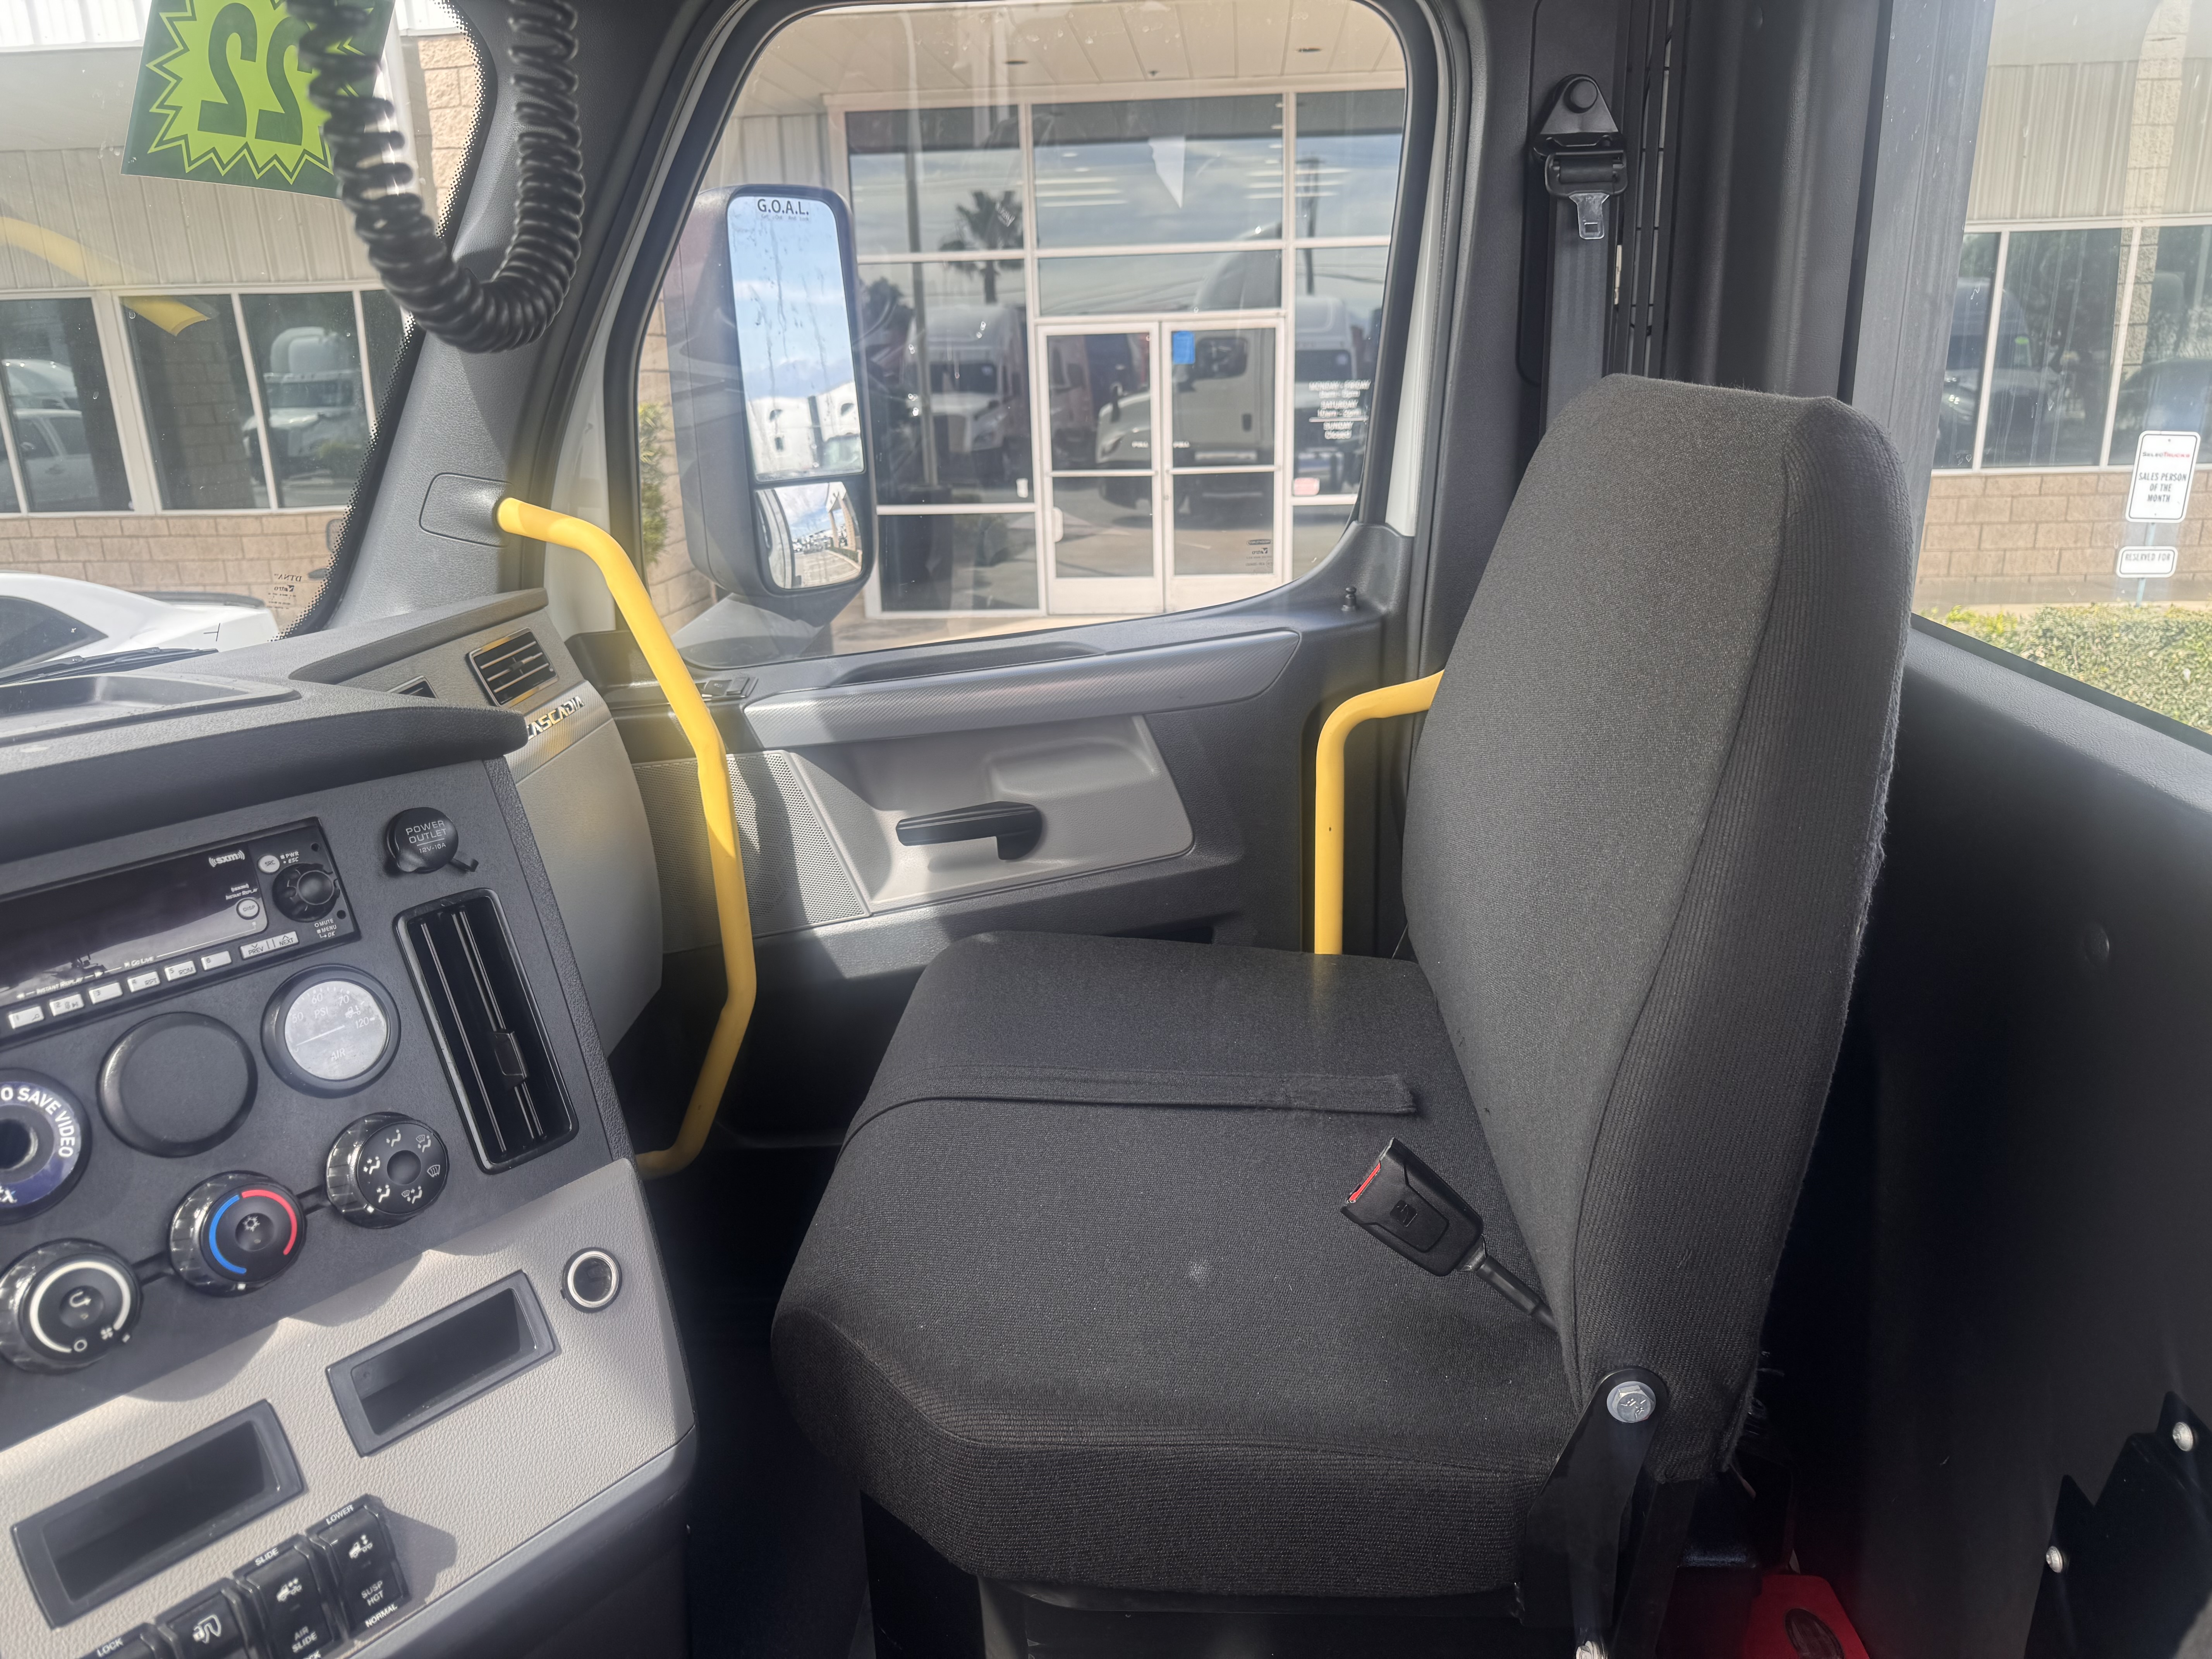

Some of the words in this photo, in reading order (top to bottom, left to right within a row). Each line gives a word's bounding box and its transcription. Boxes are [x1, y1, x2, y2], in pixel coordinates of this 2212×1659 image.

[757, 199, 809, 215] G.O.A.L.
[2139, 472, 2159, 481] SALES
[2161, 473, 2186, 481] PERSON
[2150, 483, 2158, 492] OF
[2160, 484, 2172, 492] THE
[2125, 553, 2155, 562] RESERVED
[2158, 553, 2170, 562] FOR
[405, 820, 445, 835] POWER
[409, 828, 447, 843] OUTLET
[319, 918, 334, 926] MUTE
[321, 924, 337, 933] MENU
[279, 938, 294, 946] NEXT
[248, 946, 263, 955] PREV
[311, 993, 323, 1004] 60
[338, 995, 349, 1006] 70
[292, 1012, 304, 1024] 50
[314, 1006, 328, 1019] PSI
[356, 1017, 369, 1029] 120
[331, 1048, 345, 1061] AIR
[17, 1087, 61, 1115] SAVE
[55, 1110, 75, 1158] VIDEO
[326, 1504, 354, 1525] LOWER
[255, 1547, 279, 1566] SLIDE
[361, 1580, 383, 1599] SUSP
[367, 1590, 384, 1607] HGT
[365, 1603, 398, 1628] NORMAL
[295, 1626, 309, 1641] AIR
[97, 1638, 124, 1657] LOCK
[292, 1631, 317, 1653] SLIDE
